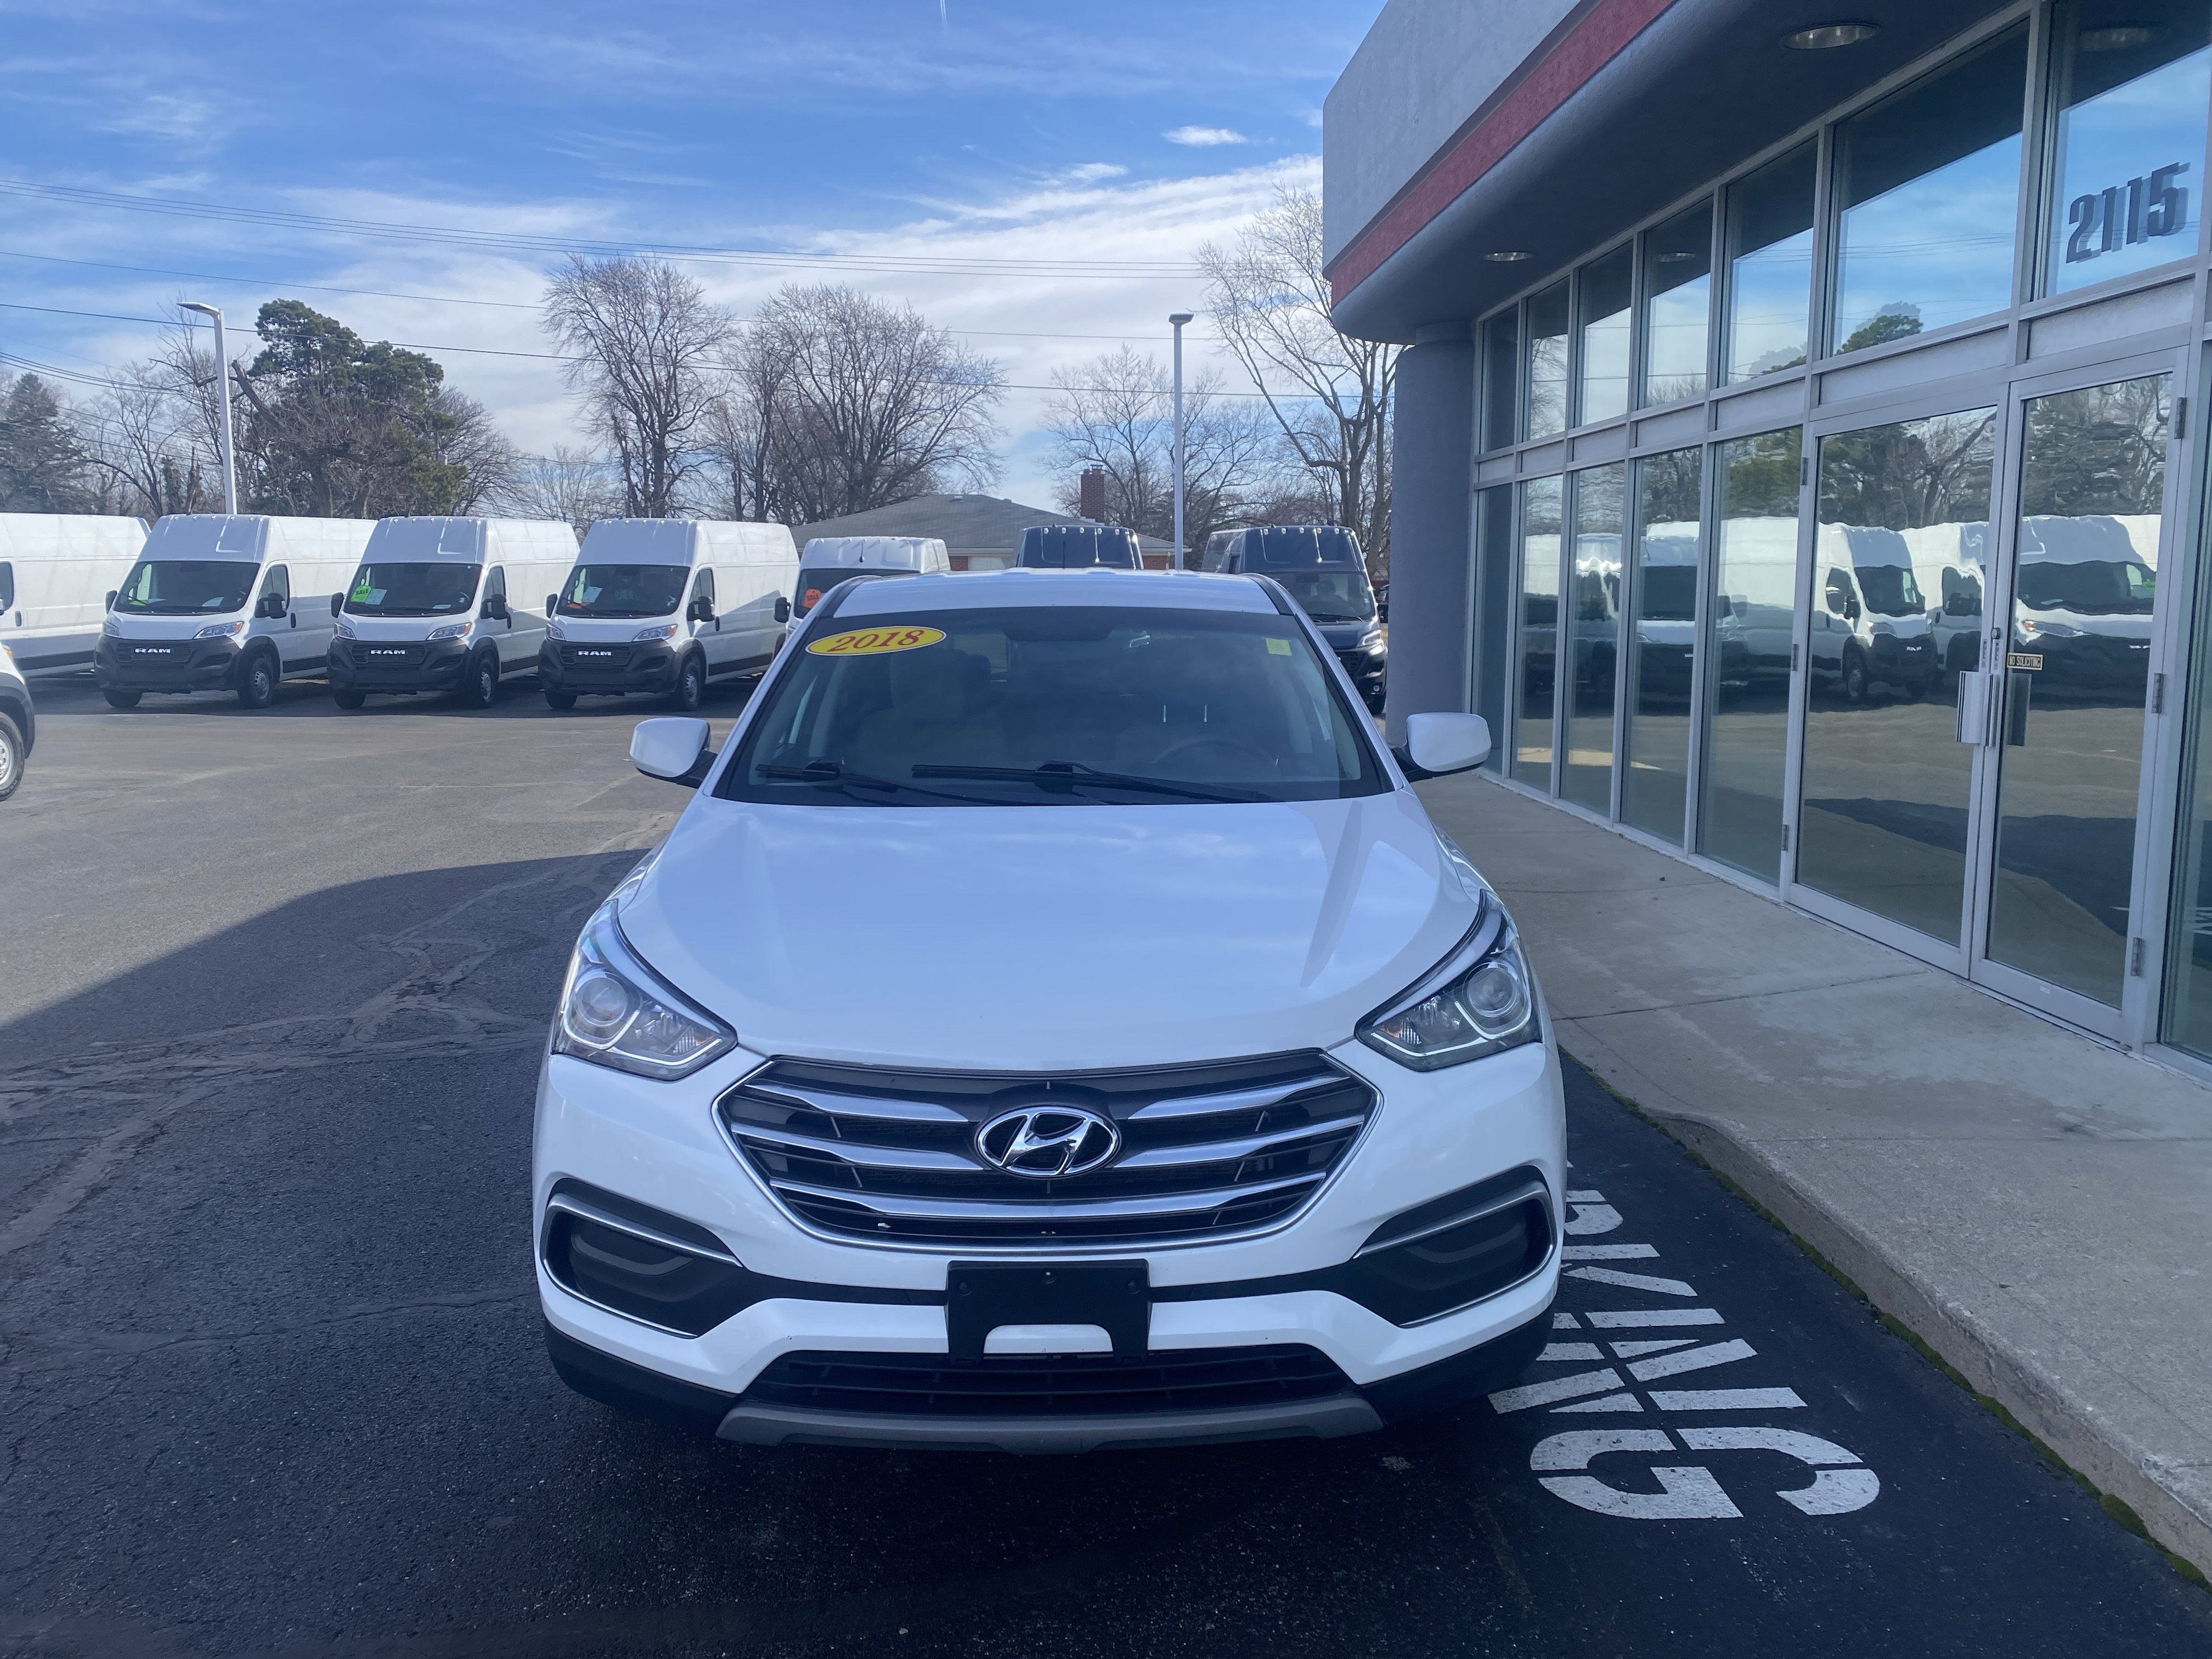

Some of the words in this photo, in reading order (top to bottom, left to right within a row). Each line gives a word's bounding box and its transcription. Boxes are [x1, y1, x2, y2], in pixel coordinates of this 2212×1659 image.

[2066, 162, 2182, 264] 2115
[827, 630, 924, 652] 2018
[2009, 656, 2016, 665] NO
[2016, 656, 2040, 667] SOLICITING
